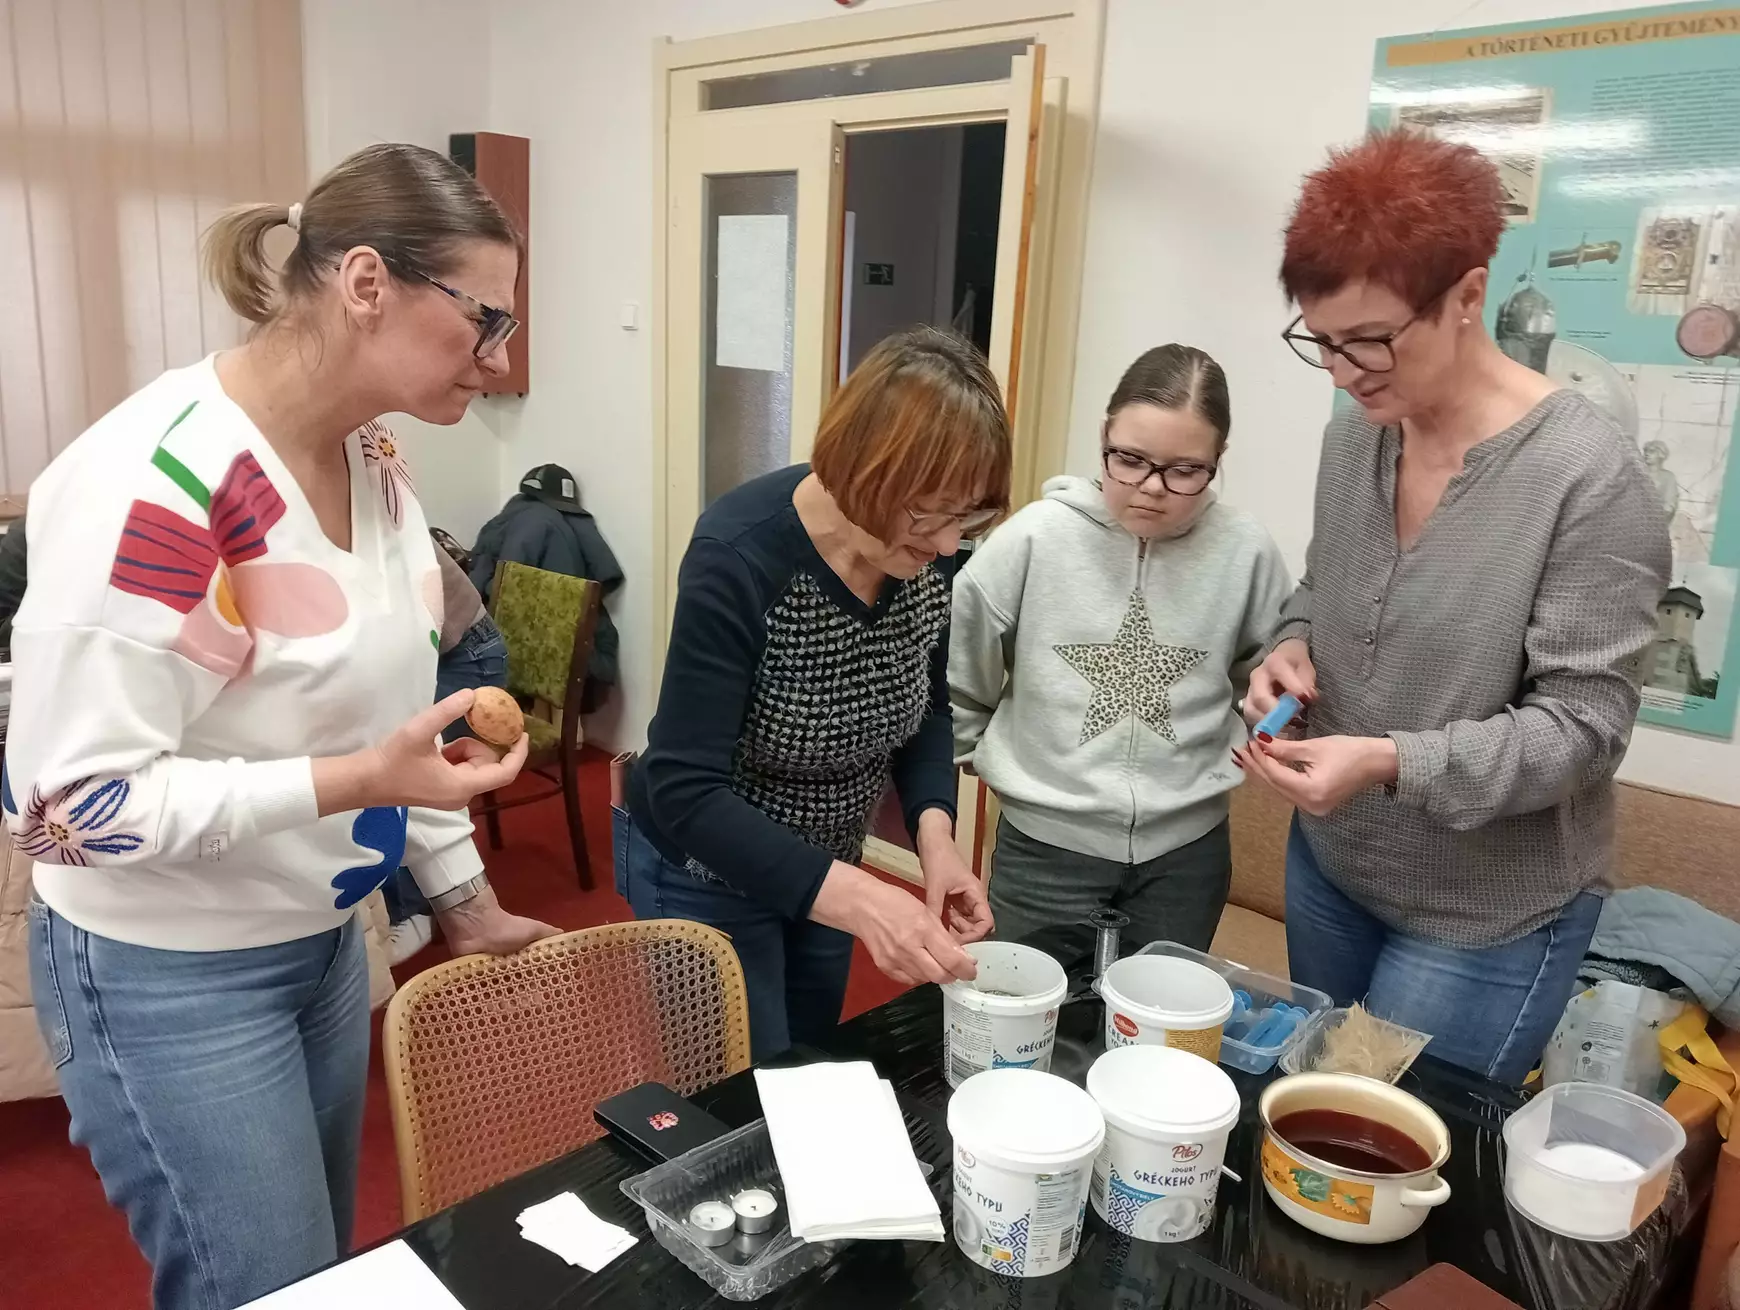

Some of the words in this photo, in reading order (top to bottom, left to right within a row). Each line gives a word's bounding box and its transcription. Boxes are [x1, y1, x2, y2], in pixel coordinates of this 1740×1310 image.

[1463, 44, 1475, 57] A
[1480, 31, 1589, 56] TÖRTÉNETI
[1172, 1145, 1197, 1159] Pilos
[1133, 1169, 1195, 1187] GRÉCKEHO
[1171, 1165, 1197, 1173] JOGURT
[976, 1191, 1003, 1212] TYPU
